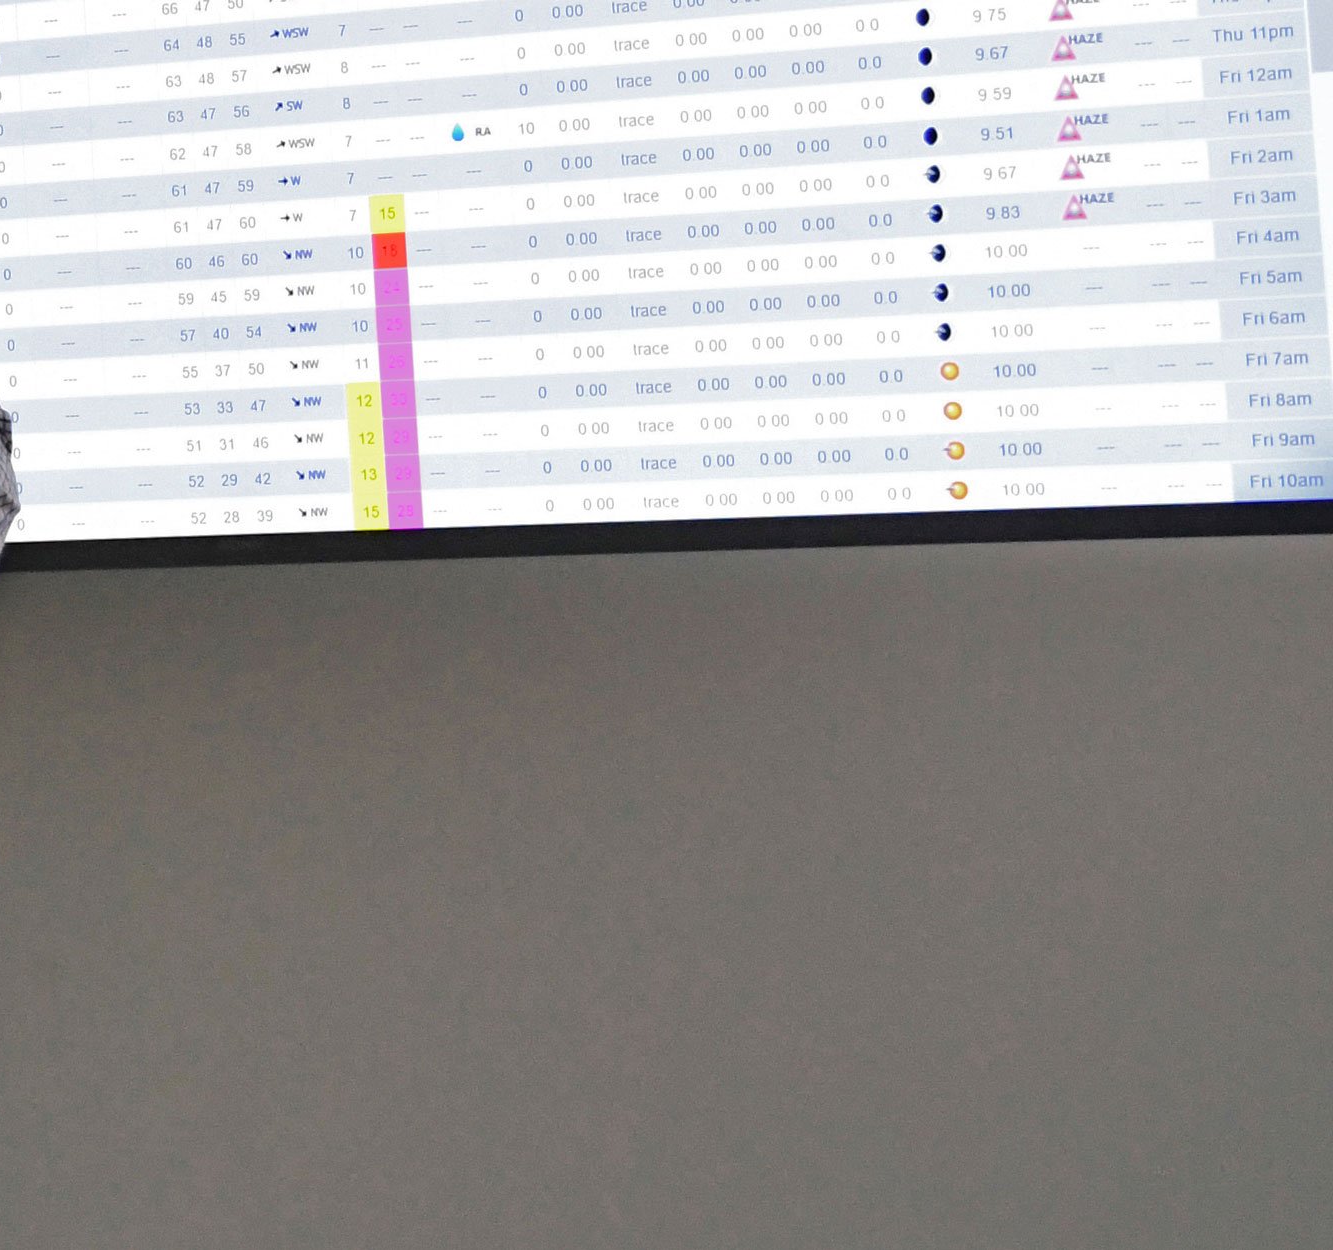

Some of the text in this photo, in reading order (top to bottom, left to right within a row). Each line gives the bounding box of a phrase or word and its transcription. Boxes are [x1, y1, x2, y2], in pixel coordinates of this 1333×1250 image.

[282, 27, 309, 38] WSW
[1067, 32, 1103, 44] HAZE
[1213, 26, 1293, 42] Thu 11pm
[284, 63, 310, 74] WSW
[616, 76, 651, 88] trace
[1069, 73, 1105, 87] HAZE
[1220, 68, 1292, 84] Fri 12am
[286, 100, 302, 111] SW
[1073, 114, 1108, 127] HAZE
[1228, 109, 1290, 124] Fri 1am
[476, 127, 491, 136] RA
[288, 138, 315, 148] WSW
[621, 154, 657, 166] trace
[1075, 153, 1110, 166] HAZE
[1231, 150, 1293, 165] Fri 2am
[1078, 192, 1114, 206] HAZE
[1234, 190, 1296, 205] Fri 3am
[380, 207, 396, 219] 15
[626, 230, 661, 242] trace
[1237, 230, 1299, 245] Fri 4am
[295, 249, 312, 260] NW
[1240, 270, 1302, 285] Fri 5am
[298, 286, 314, 296] NW
[631, 305, 666, 318] trace
[1243, 311, 1305, 326] Fri 6am
[300, 322, 317, 332] NW
[634, 344, 669, 355] trace
[302, 360, 319, 369] NW
[1246, 352, 1308, 366] Fri 7am
[636, 382, 671, 394] trace
[304, 397, 321, 406] NW
[357, 394, 372, 407] 12
[1249, 393, 1312, 407] Fri 8am
[307, 433, 323, 443] NW
[359, 432, 374, 445] 12
[1252, 433, 1315, 447] Fri 9am
[641, 458, 676, 470] trace
[309, 470, 326, 480] NW
[361, 468, 377, 480] 13
[1250, 474, 1323, 488] Fri 10am
[644, 497, 679, 508] trace
[311, 508, 328, 516] NW
[364, 505, 380, 518] 15
